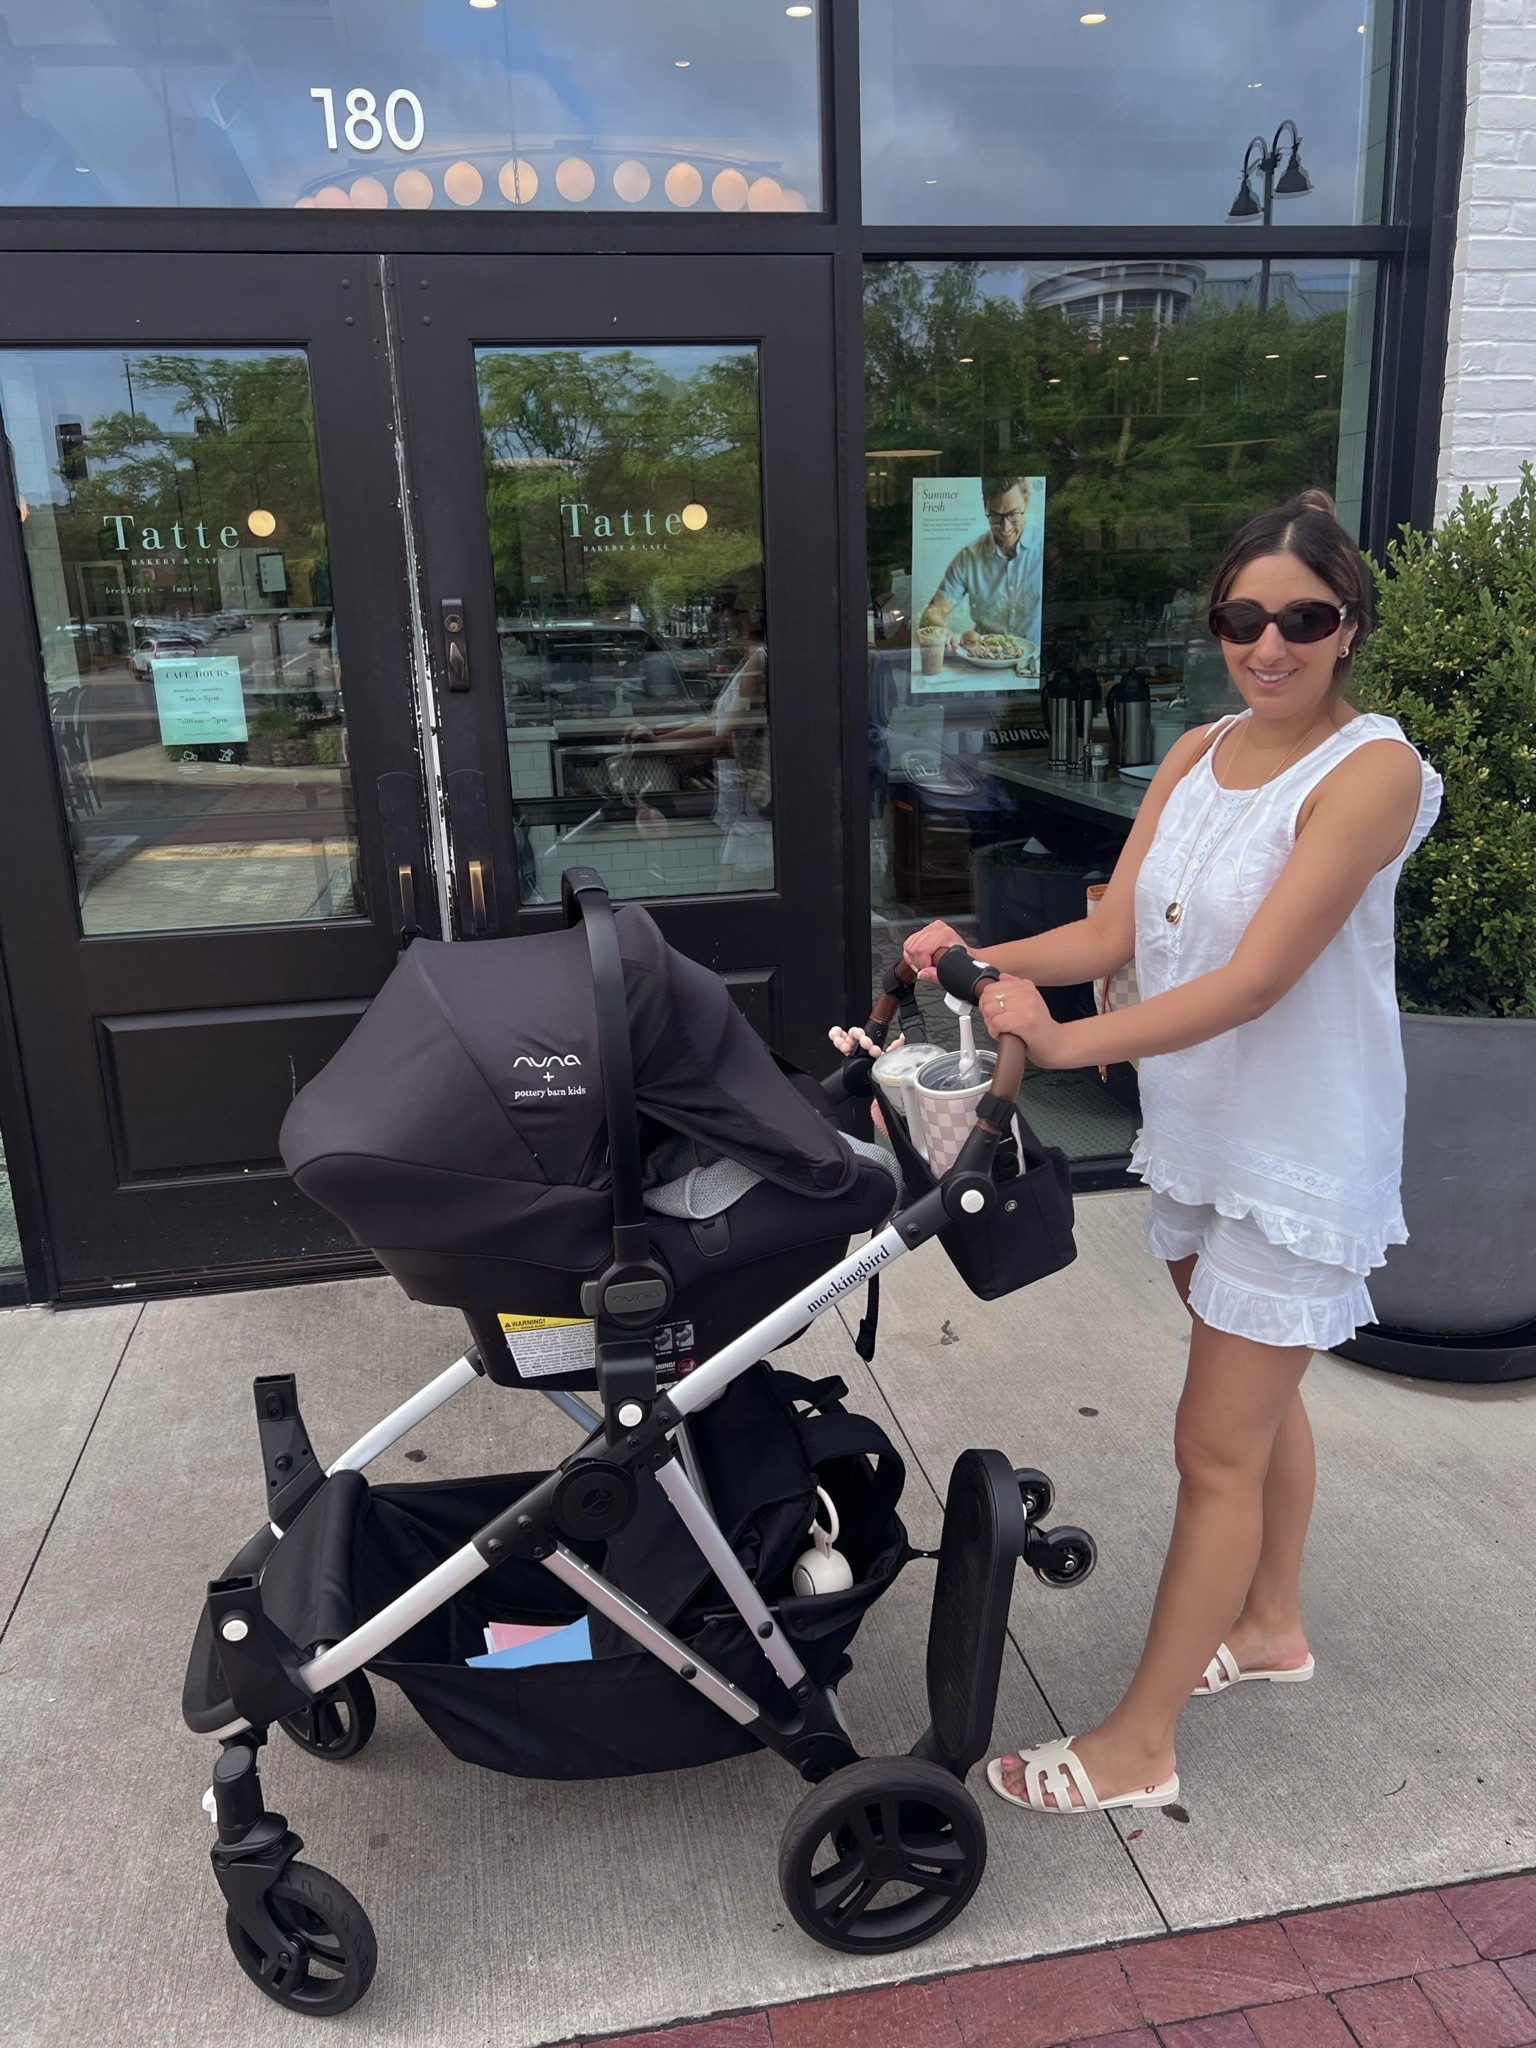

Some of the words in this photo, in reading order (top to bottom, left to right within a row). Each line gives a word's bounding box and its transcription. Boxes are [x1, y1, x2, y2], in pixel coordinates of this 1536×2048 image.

[310, 87, 424, 151] 180
[922, 489, 959, 500] Summer
[922, 501, 945, 513] Fresh
[560, 503, 681, 538] Tatte
[103, 515, 240, 551] Tatte
[131, 558, 176, 566] BAKERY
[105, 587, 151, 596] breakfast
[172, 585, 198, 593] lunch
[195, 669, 230, 679] HOURS
[989, 729, 1049, 744] BRUNCH
[513, 1054, 582, 1068] nuna
[514, 1089, 545, 1100] pottery
[547, 1087, 566, 1096] barn
[568, 1085, 587, 1096] kids
[807, 1244, 891, 1313] mockingbird
[511, 1318, 546, 1327] WARNING!
